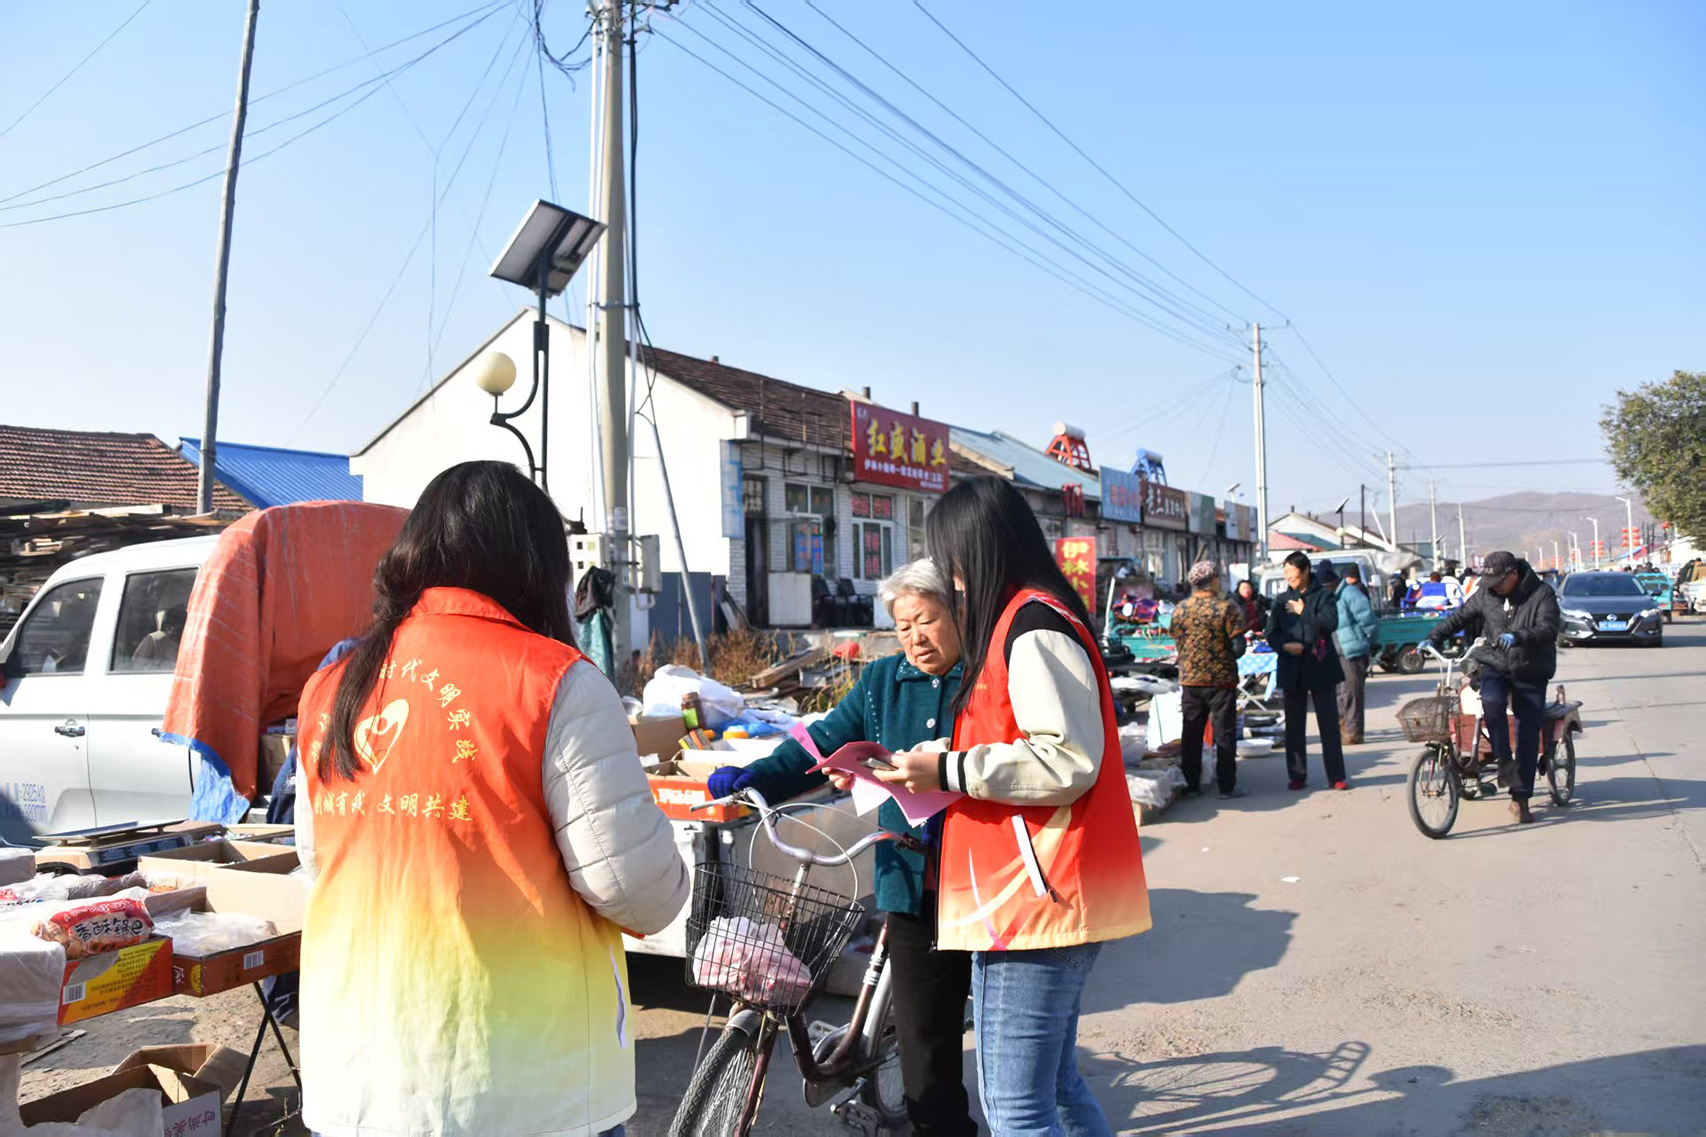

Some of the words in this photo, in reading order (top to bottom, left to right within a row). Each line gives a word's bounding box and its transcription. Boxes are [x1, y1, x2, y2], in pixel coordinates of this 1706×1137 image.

[376, 790, 474, 822] 文明共建
[74, 917, 144, 943] 香酥锅巴
